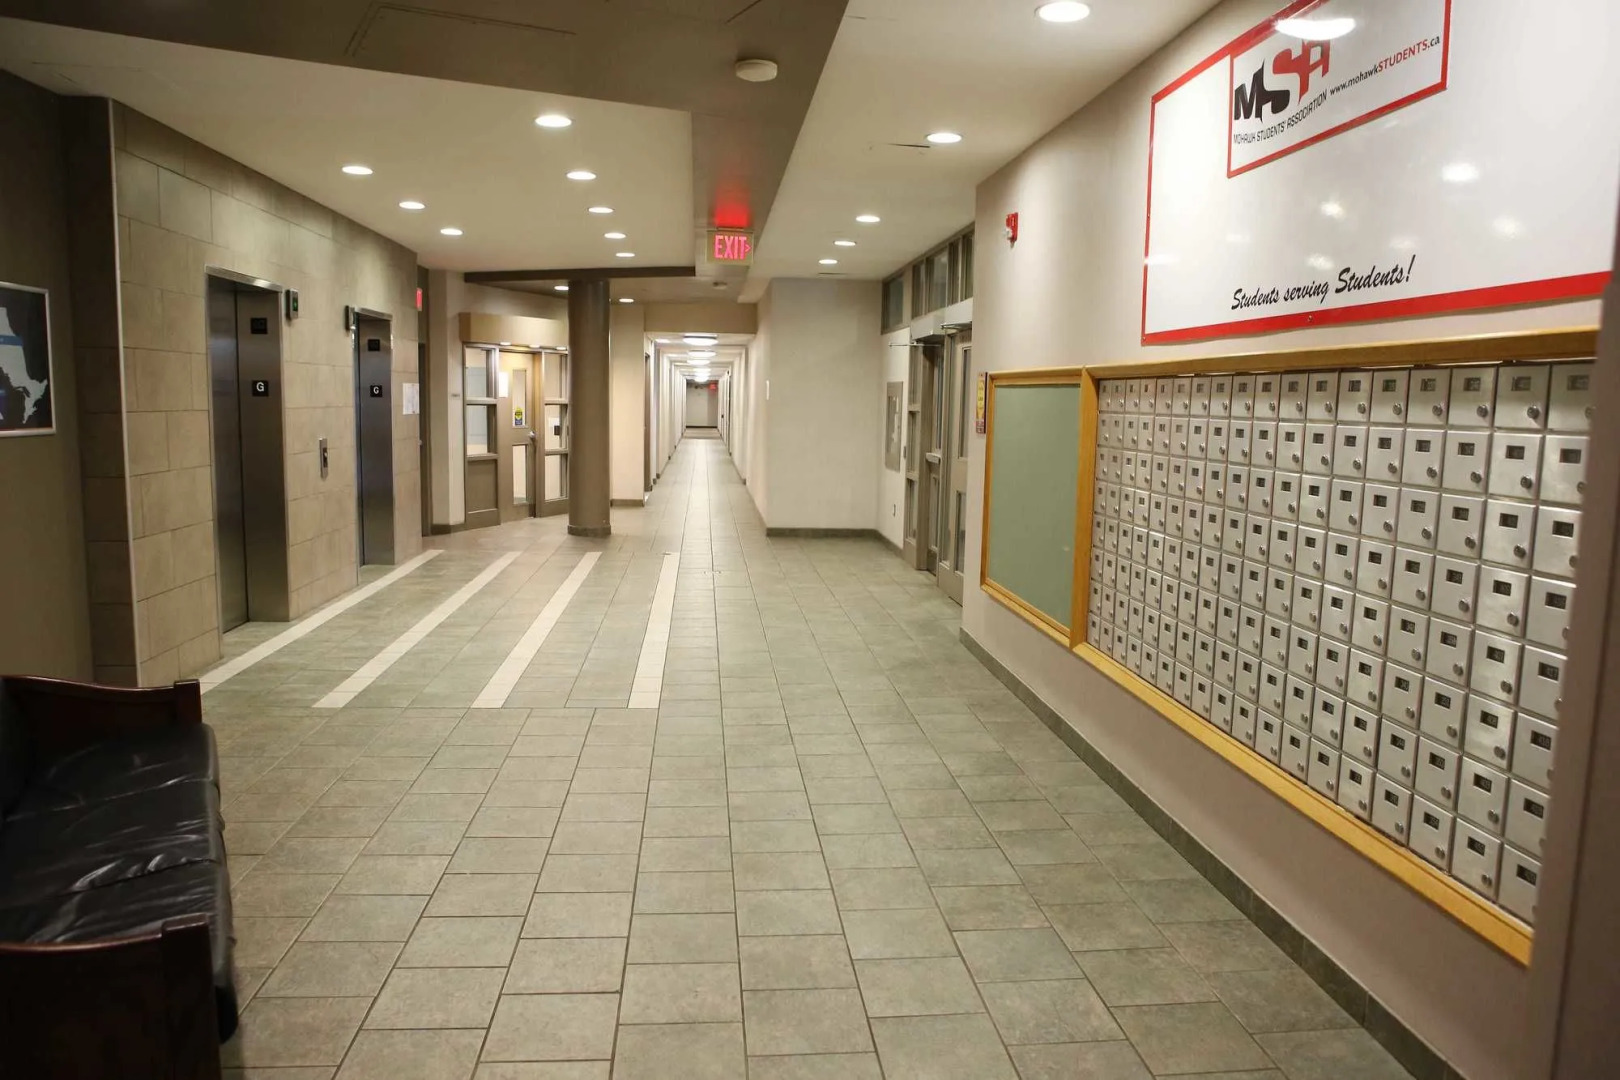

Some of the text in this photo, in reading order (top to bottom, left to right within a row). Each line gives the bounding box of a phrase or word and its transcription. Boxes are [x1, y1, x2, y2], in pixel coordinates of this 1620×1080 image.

[1286, 88, 1327, 129] ASSOCIATION
[1329, 35, 1440, 96] www.mohawkSTUDENTS.ca
[715, 235, 747, 260] EXIT
[1231, 254, 1416, 310] Students serving Students!
[256, 381, 265, 392] G
[373, 386, 379, 394] G
